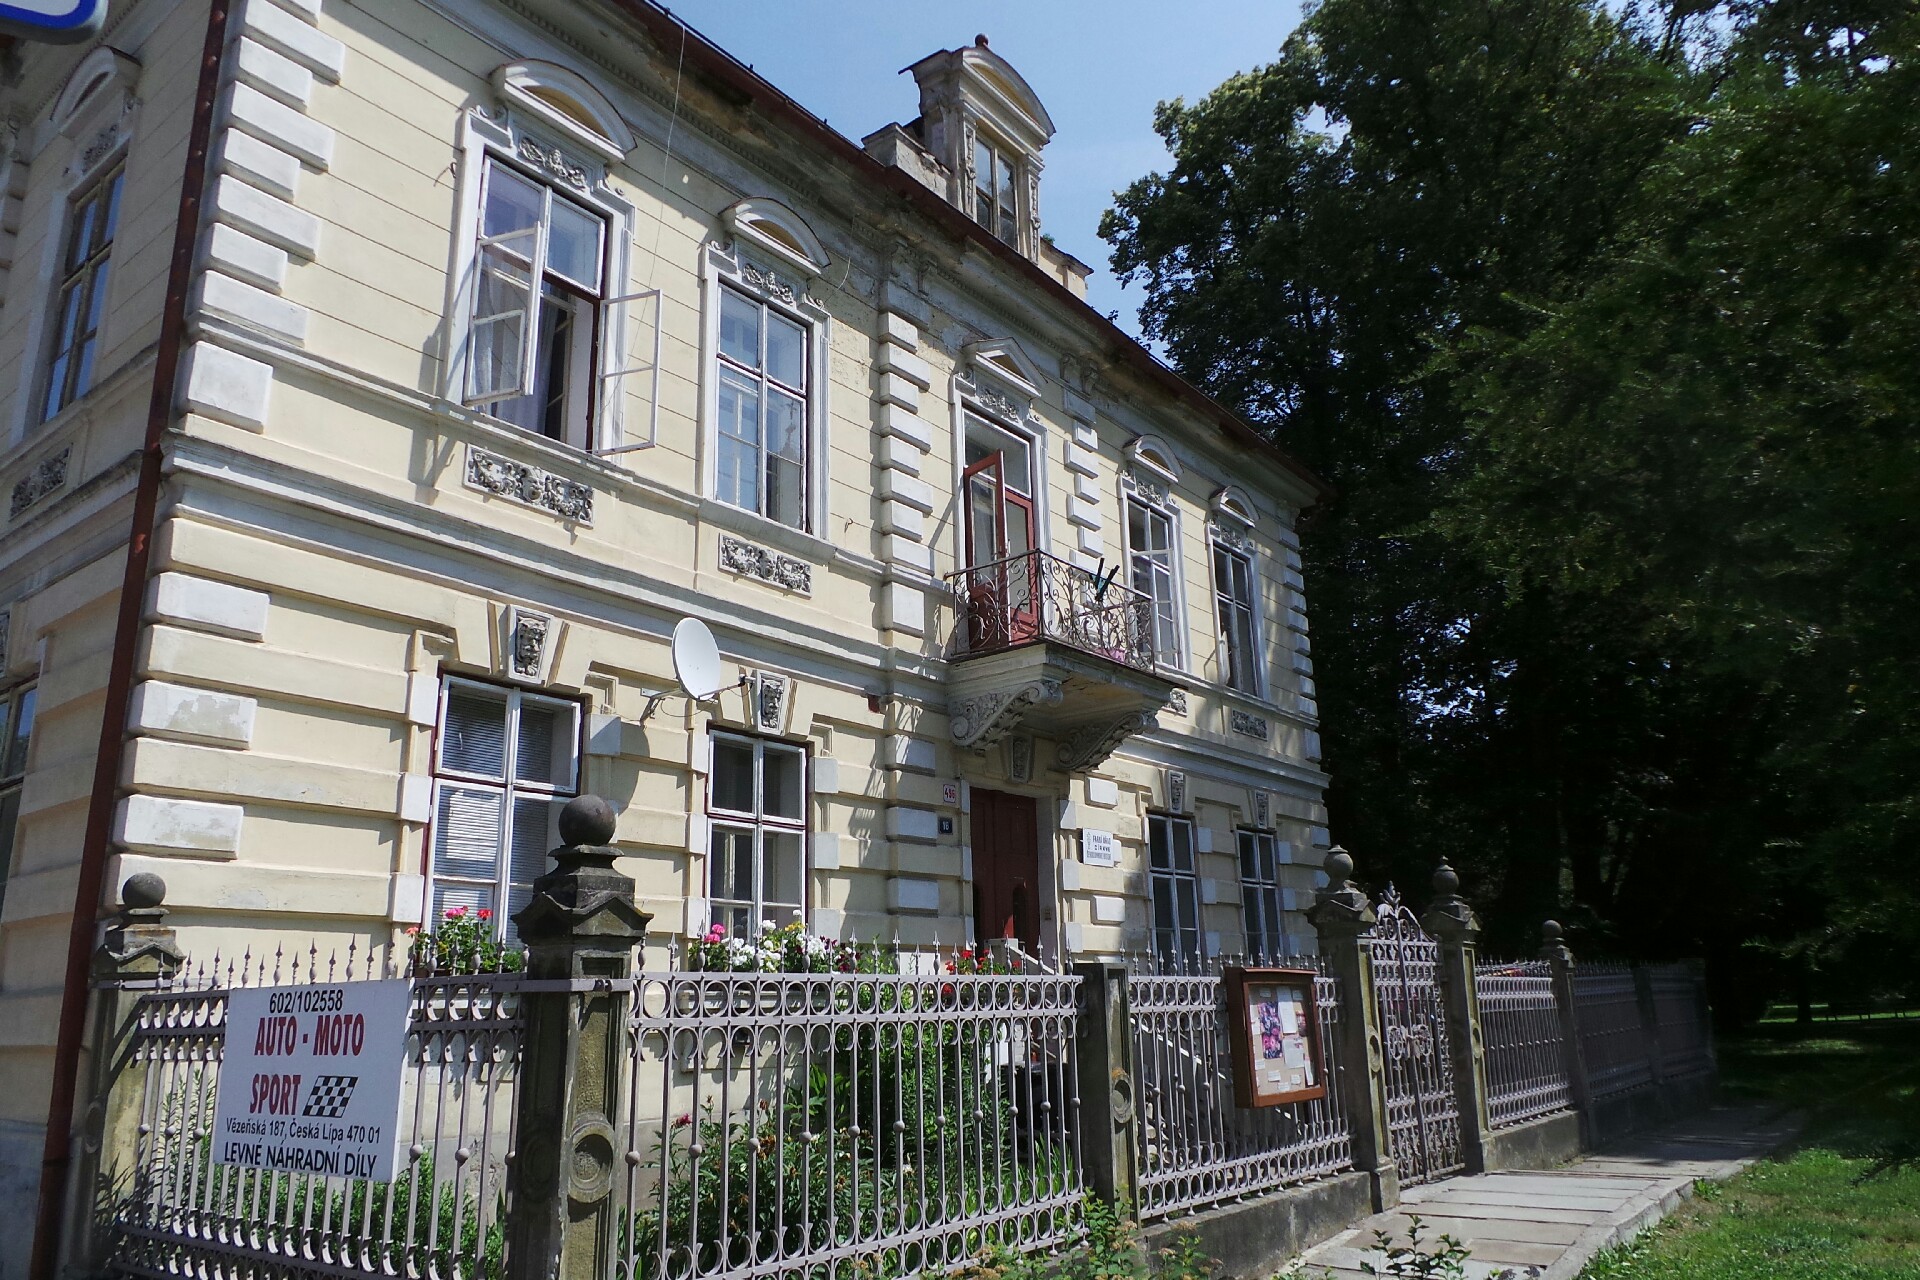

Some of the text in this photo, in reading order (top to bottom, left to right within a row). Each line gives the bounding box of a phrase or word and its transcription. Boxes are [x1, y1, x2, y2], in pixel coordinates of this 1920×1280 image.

[942, 821, 950, 831] 16
[269, 989, 343, 1014] 602/102558
[254, 1015, 297, 1056] AUTO
[312, 1013, 365, 1056] MOTO
[249, 1073, 302, 1116] SPORT
[269, 1120, 287, 1140] 187,
[289, 1118, 320, 1139] Česká
[322, 1122, 344, 1145] Lípa
[346, 1124, 366, 1143] 470
[367, 1126, 381, 1144] 01
[224, 1137, 378, 1178] LEVNÉ NÁHRADNÍ DÍLY
